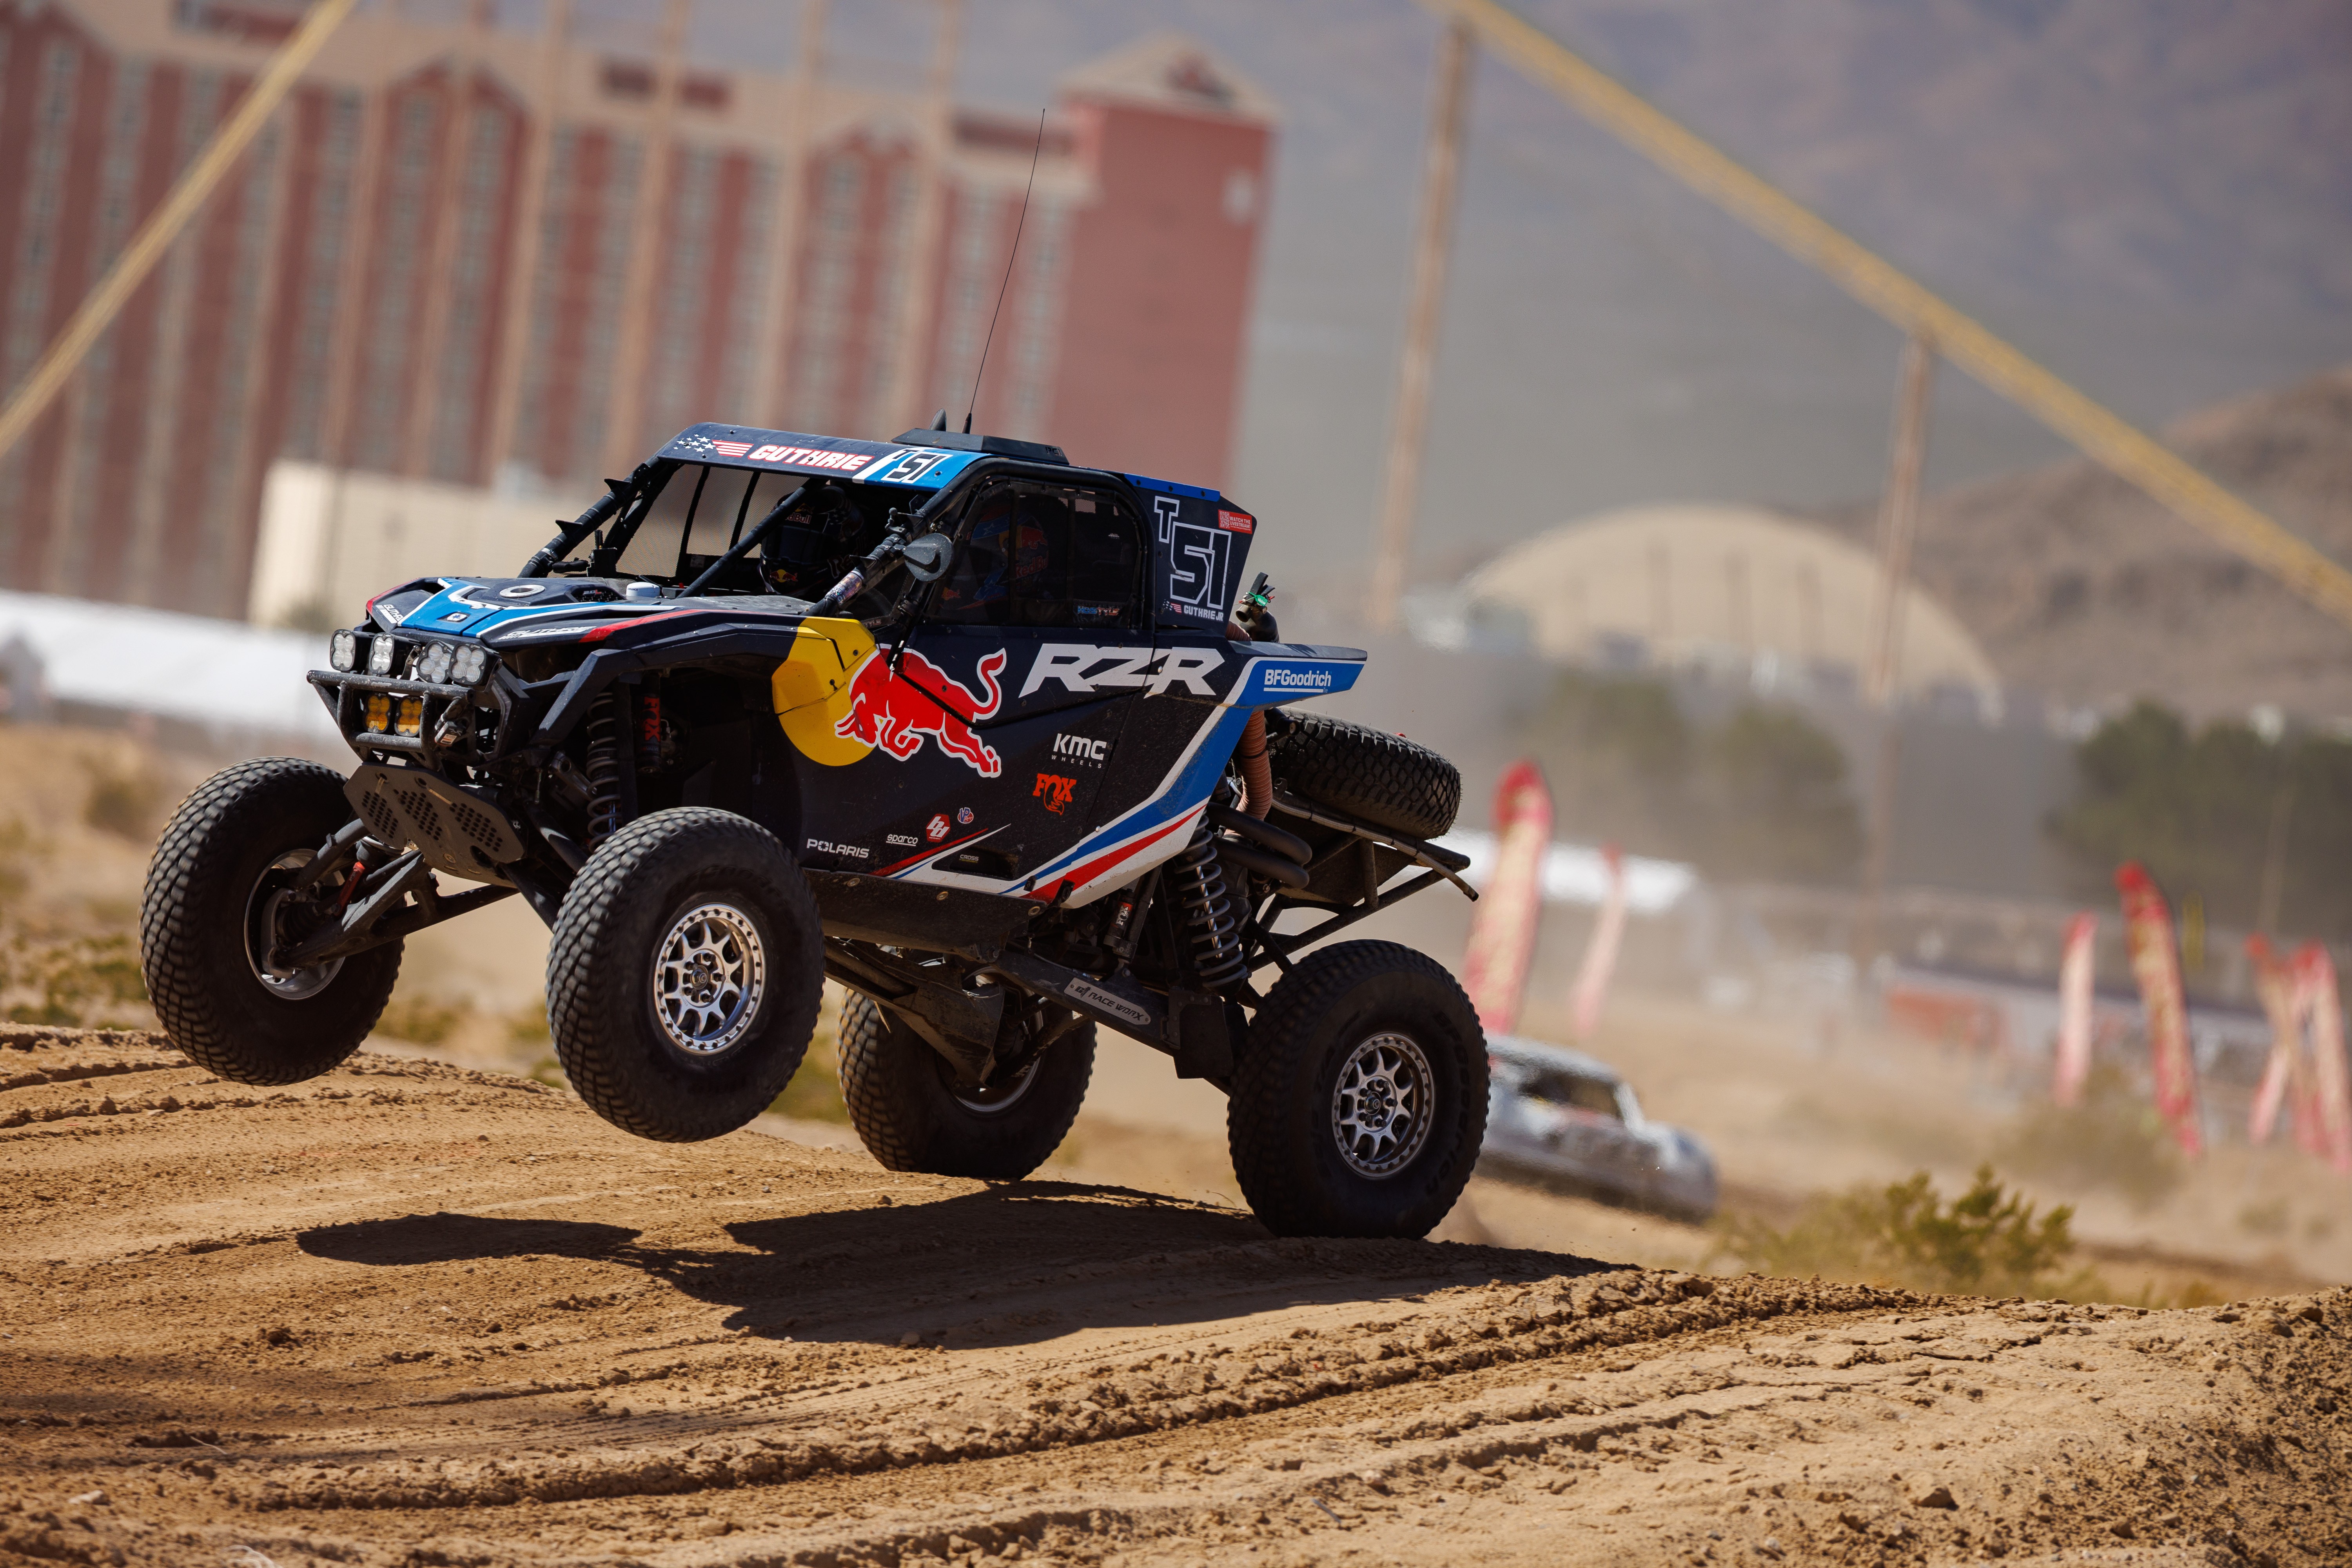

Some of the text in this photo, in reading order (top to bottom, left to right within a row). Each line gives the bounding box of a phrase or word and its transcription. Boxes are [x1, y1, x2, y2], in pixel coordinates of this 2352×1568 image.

[748, 445, 875, 471] GUTHRIE
[881, 451, 953, 484] 51
[1154, 496, 1232, 610] T 51
[1183, 604, 1223, 622] GUTHRIE JR
[1018, 643, 1225, 699] RZR
[1264, 669, 1332, 687] BFGoodrich
[1051, 755, 1102, 769] WHEELS
[1033, 773, 1077, 815] FOX
[959, 807, 971, 823] VP
[807, 838, 869, 858] POLARIS
[887, 834, 918, 845] sparco
[1116, 905, 1130, 926] FOX
[1088, 992, 1115, 1007] RACE
[1116, 1004, 1144, 1021] WORX
